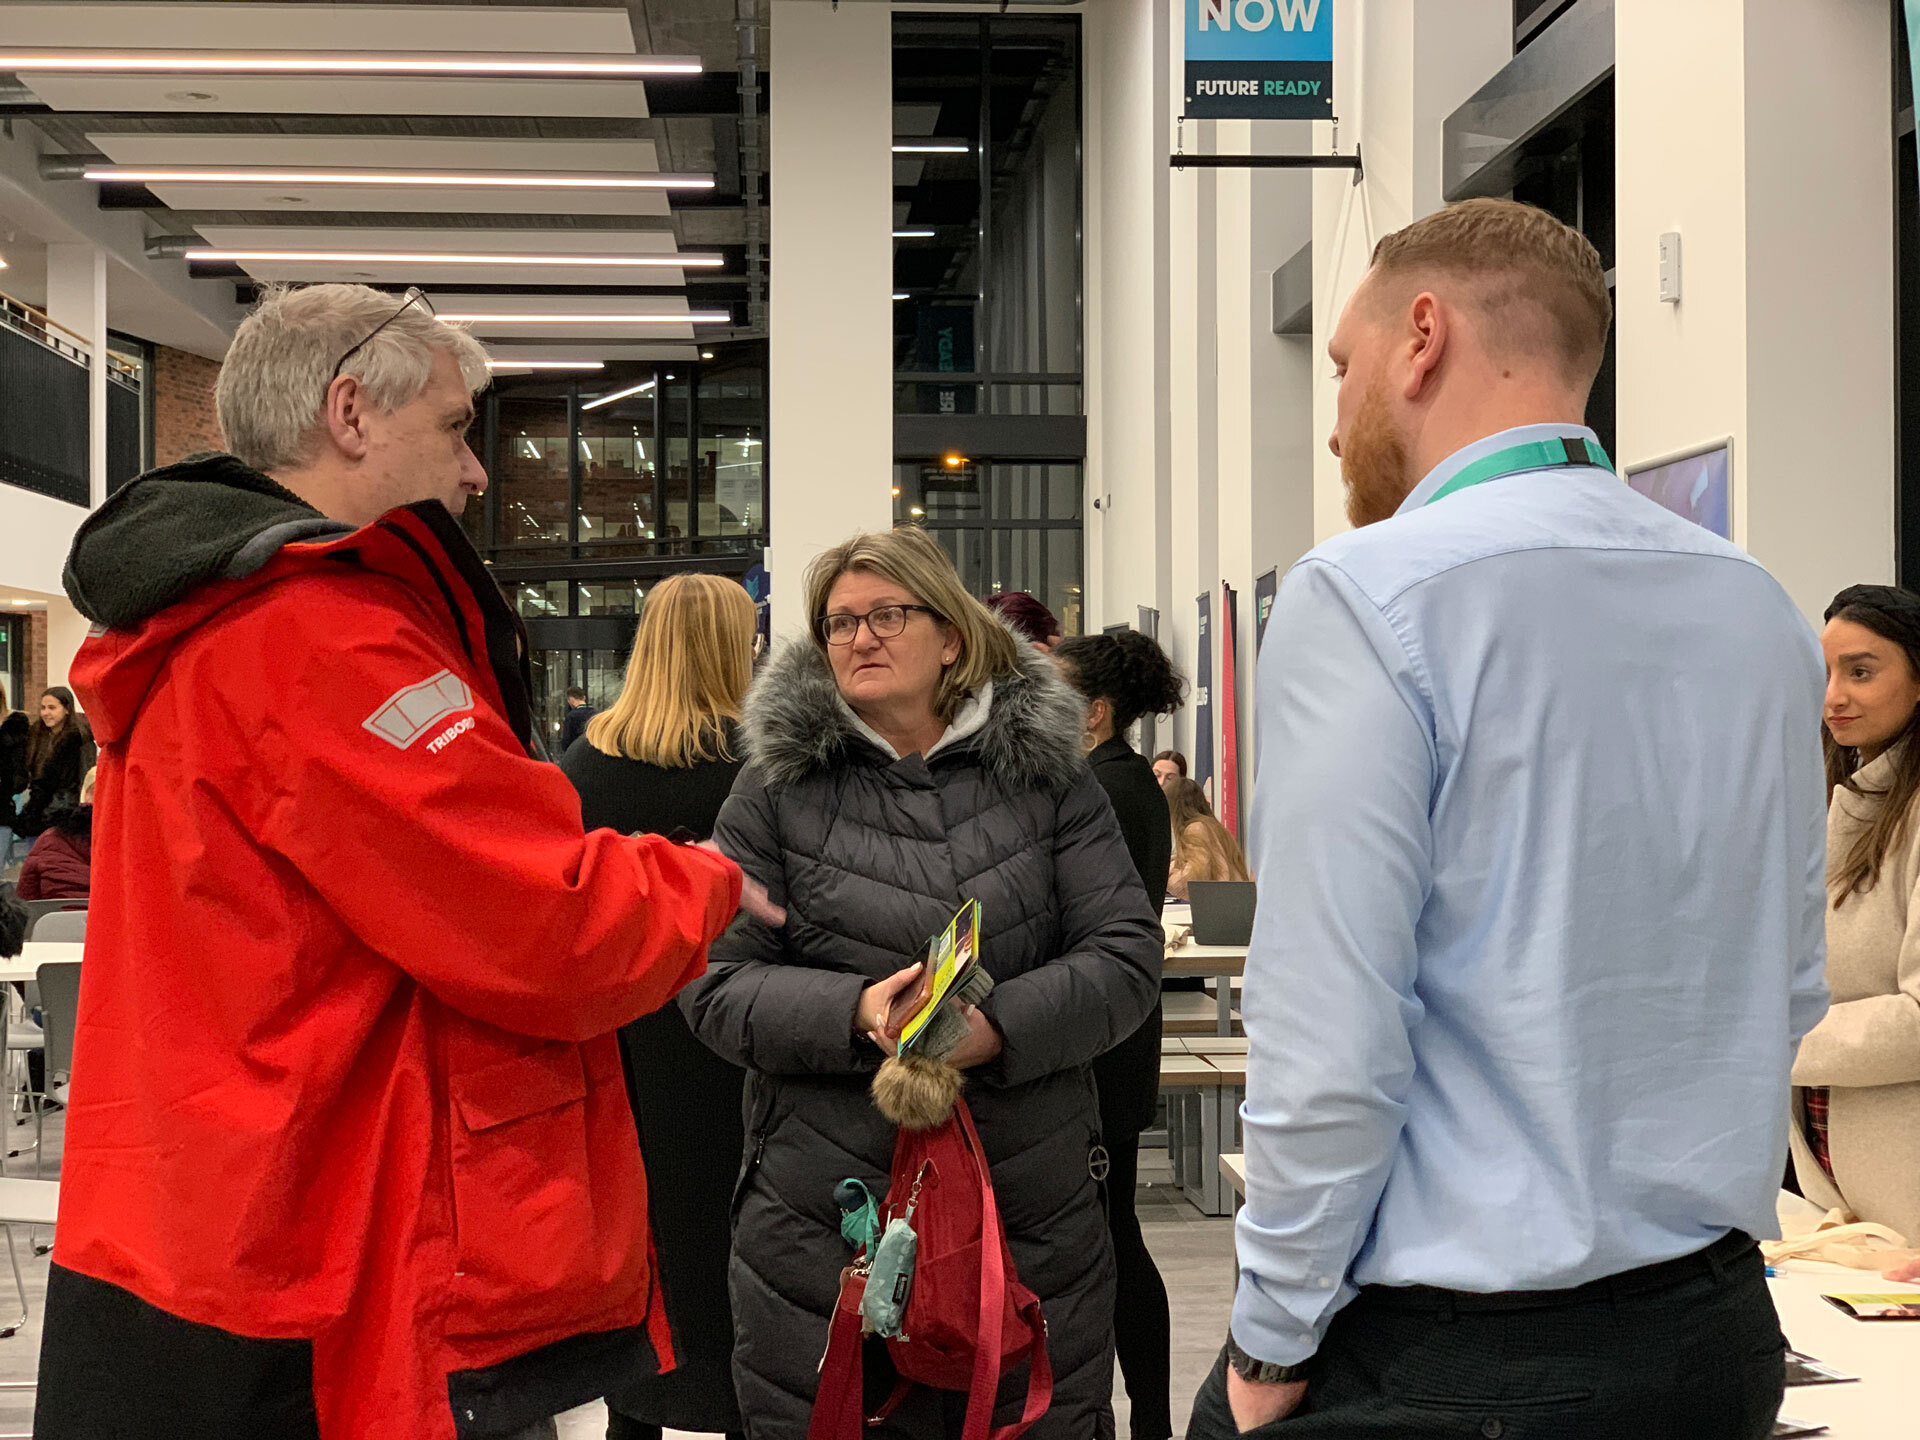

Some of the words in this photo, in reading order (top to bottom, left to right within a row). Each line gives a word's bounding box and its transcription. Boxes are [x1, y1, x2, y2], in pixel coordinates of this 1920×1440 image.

[1198, 0, 1321, 32] NOW
[1196, 80, 1259, 95] FUTURE
[1263, 80, 1321, 96] READY
